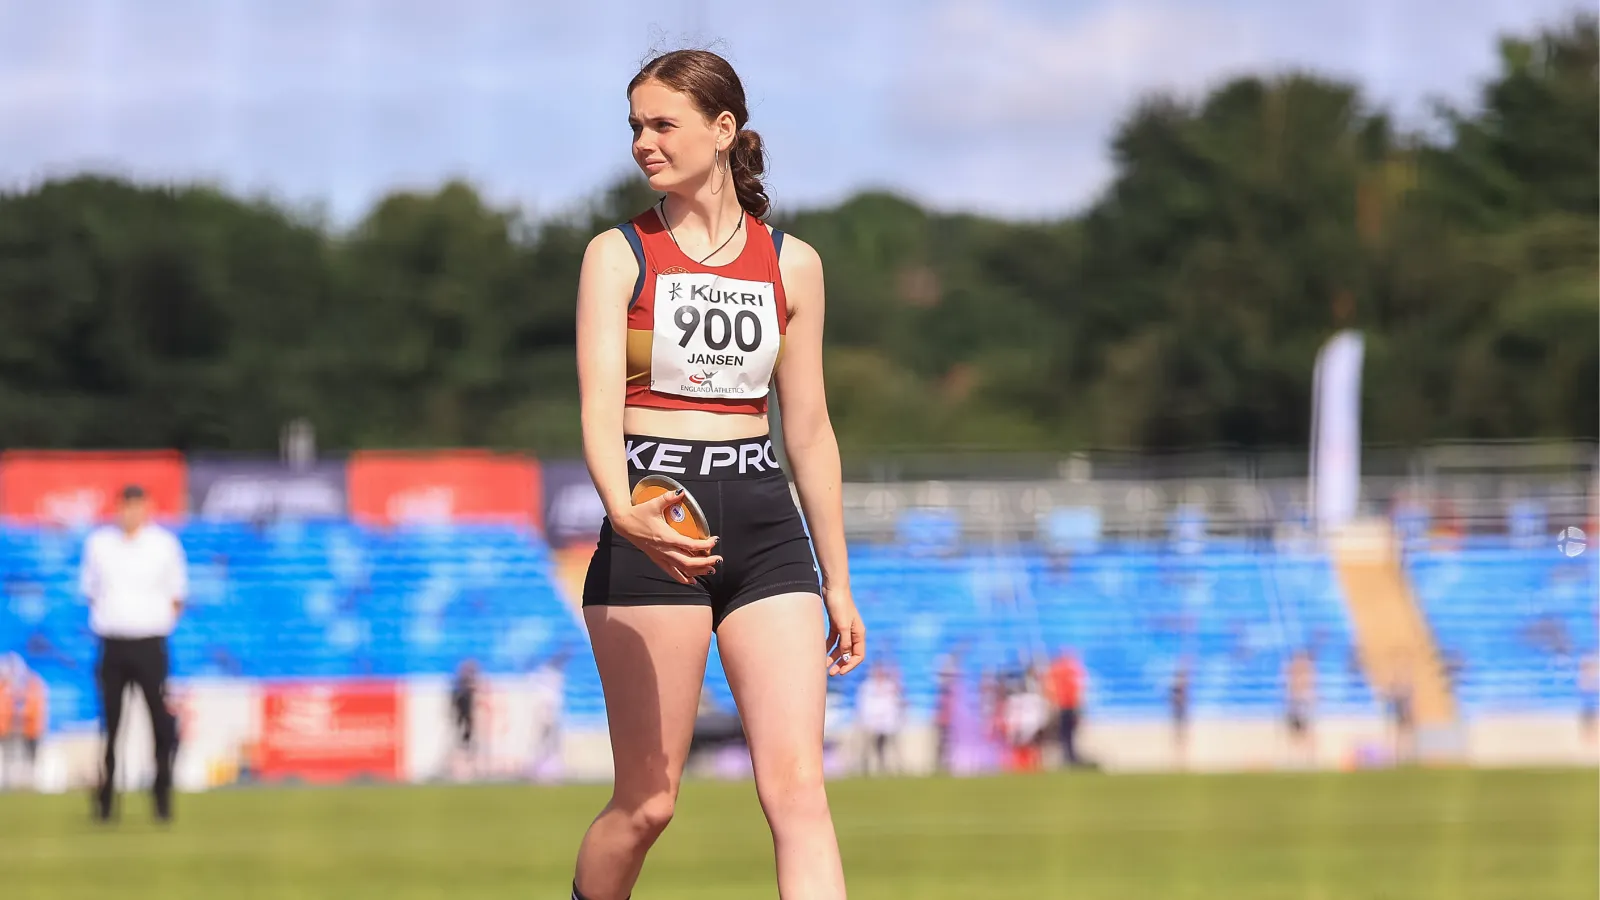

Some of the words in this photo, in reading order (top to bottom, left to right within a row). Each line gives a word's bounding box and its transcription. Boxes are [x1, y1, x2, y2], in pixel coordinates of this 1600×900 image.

[690, 284, 764, 307] KUKRI
[673, 304, 763, 353] 900
[687, 353, 744, 367] JANSEN
[680, 385, 711, 393] ENGLAND
